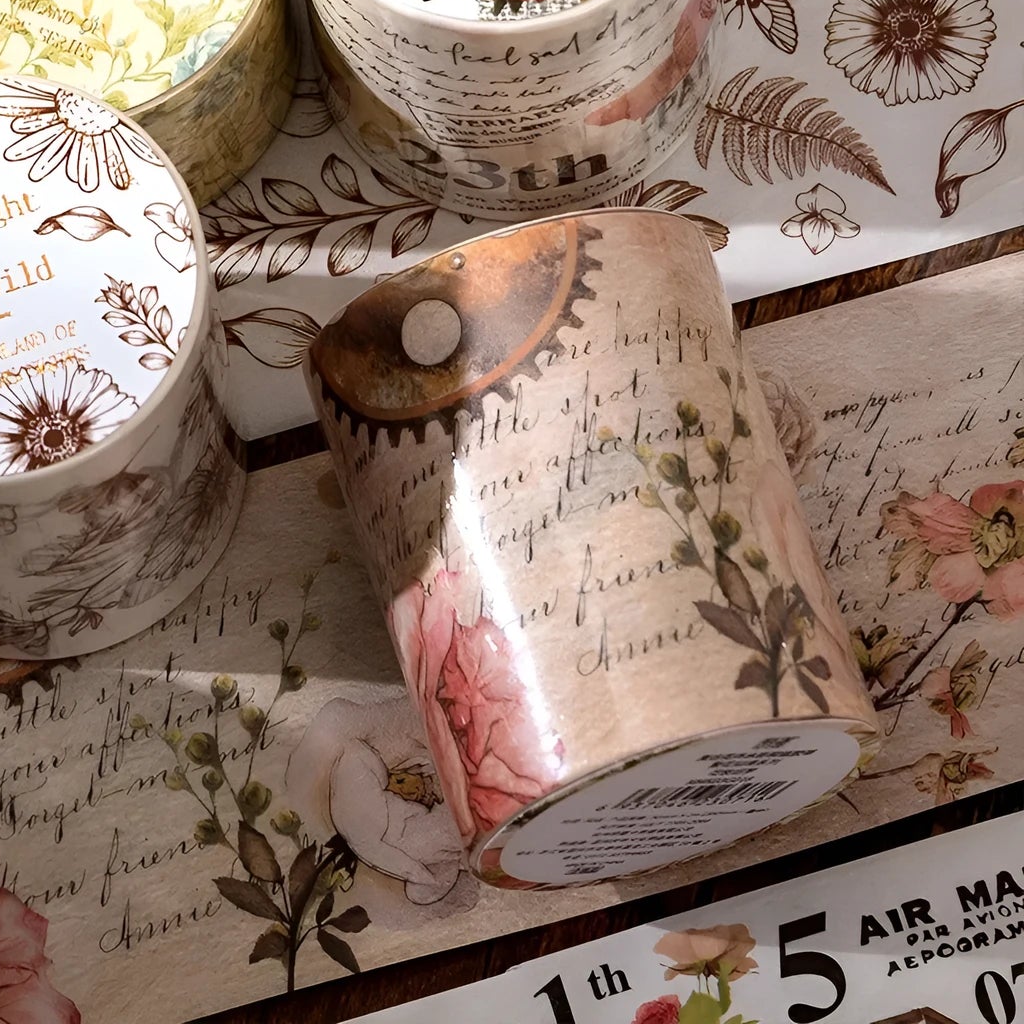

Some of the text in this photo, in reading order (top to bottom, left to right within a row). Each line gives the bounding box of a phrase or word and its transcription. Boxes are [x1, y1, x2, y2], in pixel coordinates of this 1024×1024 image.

[443, 41, 523, 67] feel
[612, 299, 715, 366] happy
[575, 615, 708, 678] Annie
[98, 887, 227, 954] Annie
[859, 866, 1024, 947] AIR MA
[778, 910, 847, 1024] 5
